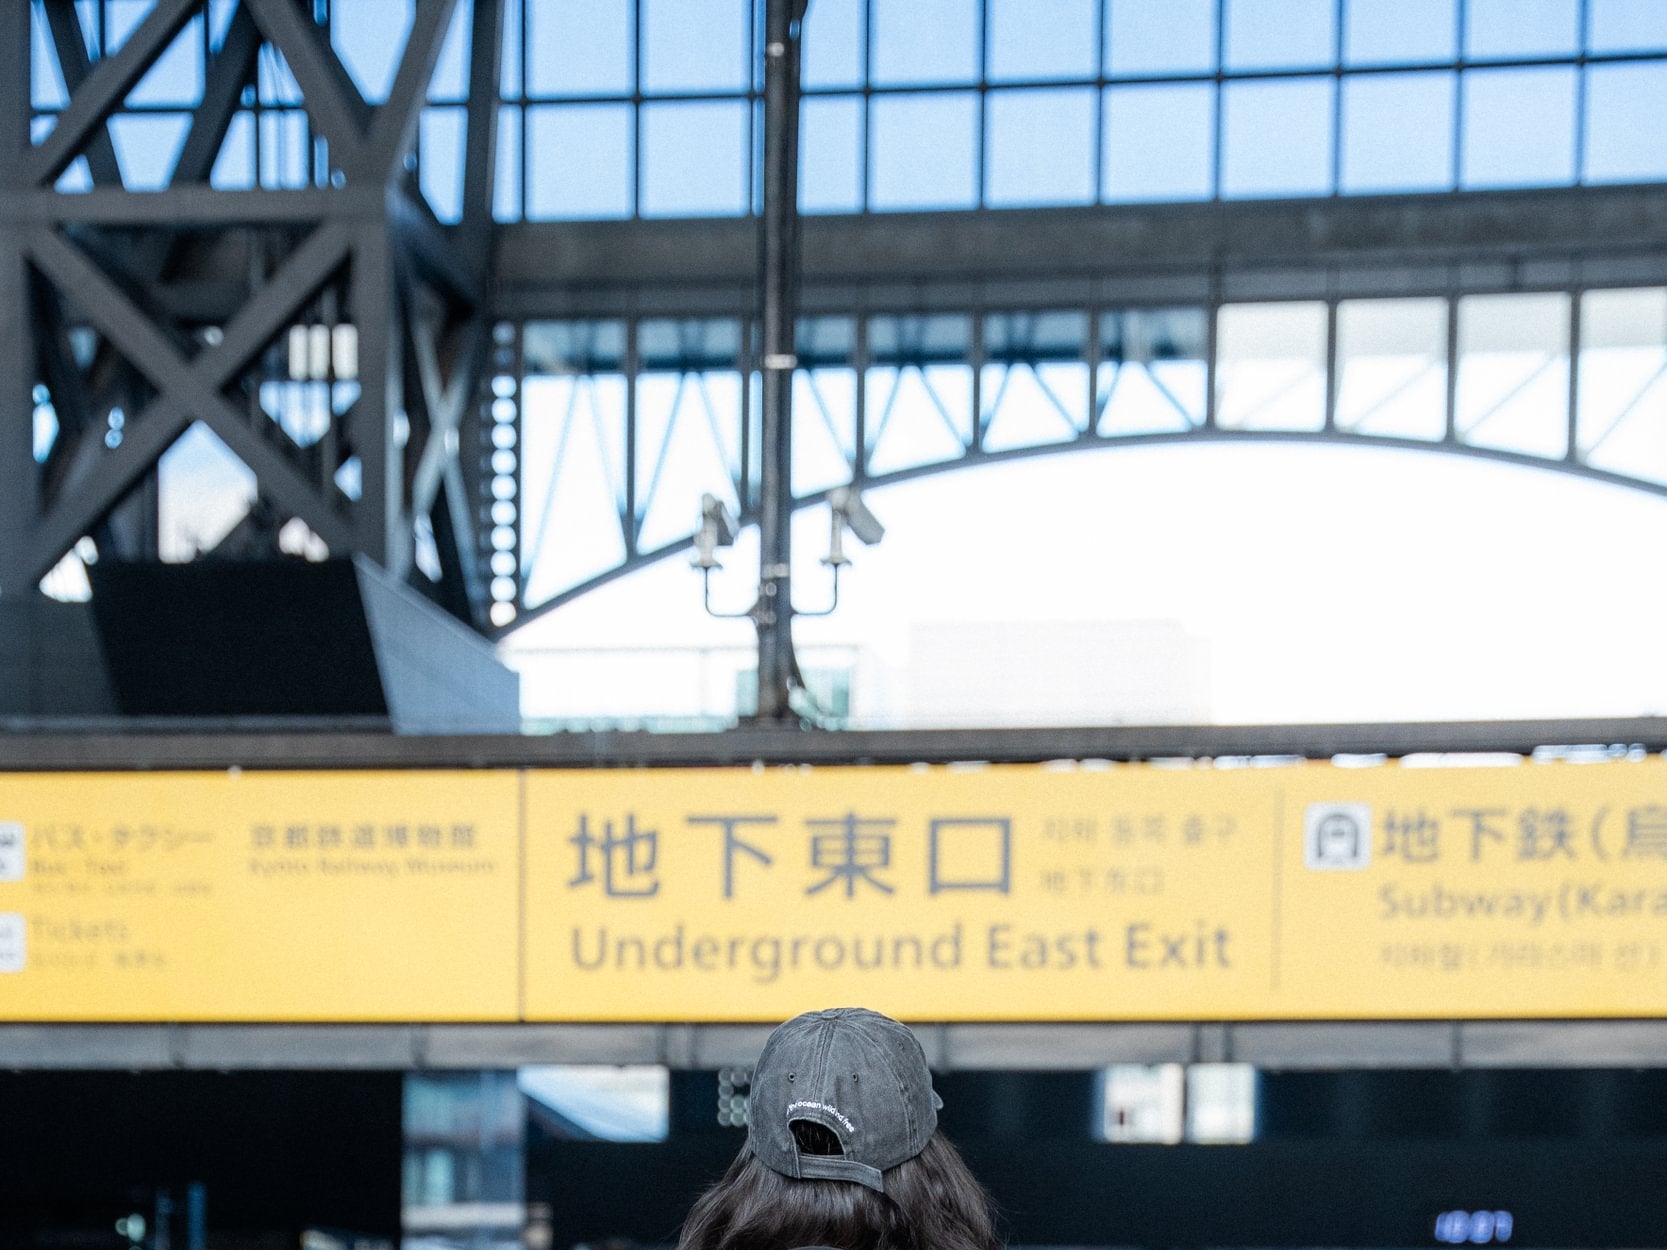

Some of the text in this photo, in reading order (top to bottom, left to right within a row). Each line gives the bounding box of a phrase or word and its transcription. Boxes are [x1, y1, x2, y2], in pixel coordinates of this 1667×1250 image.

[567, 812, 1014, 899] 地下東口
[570, 923, 1232, 981] Underground East Exit
